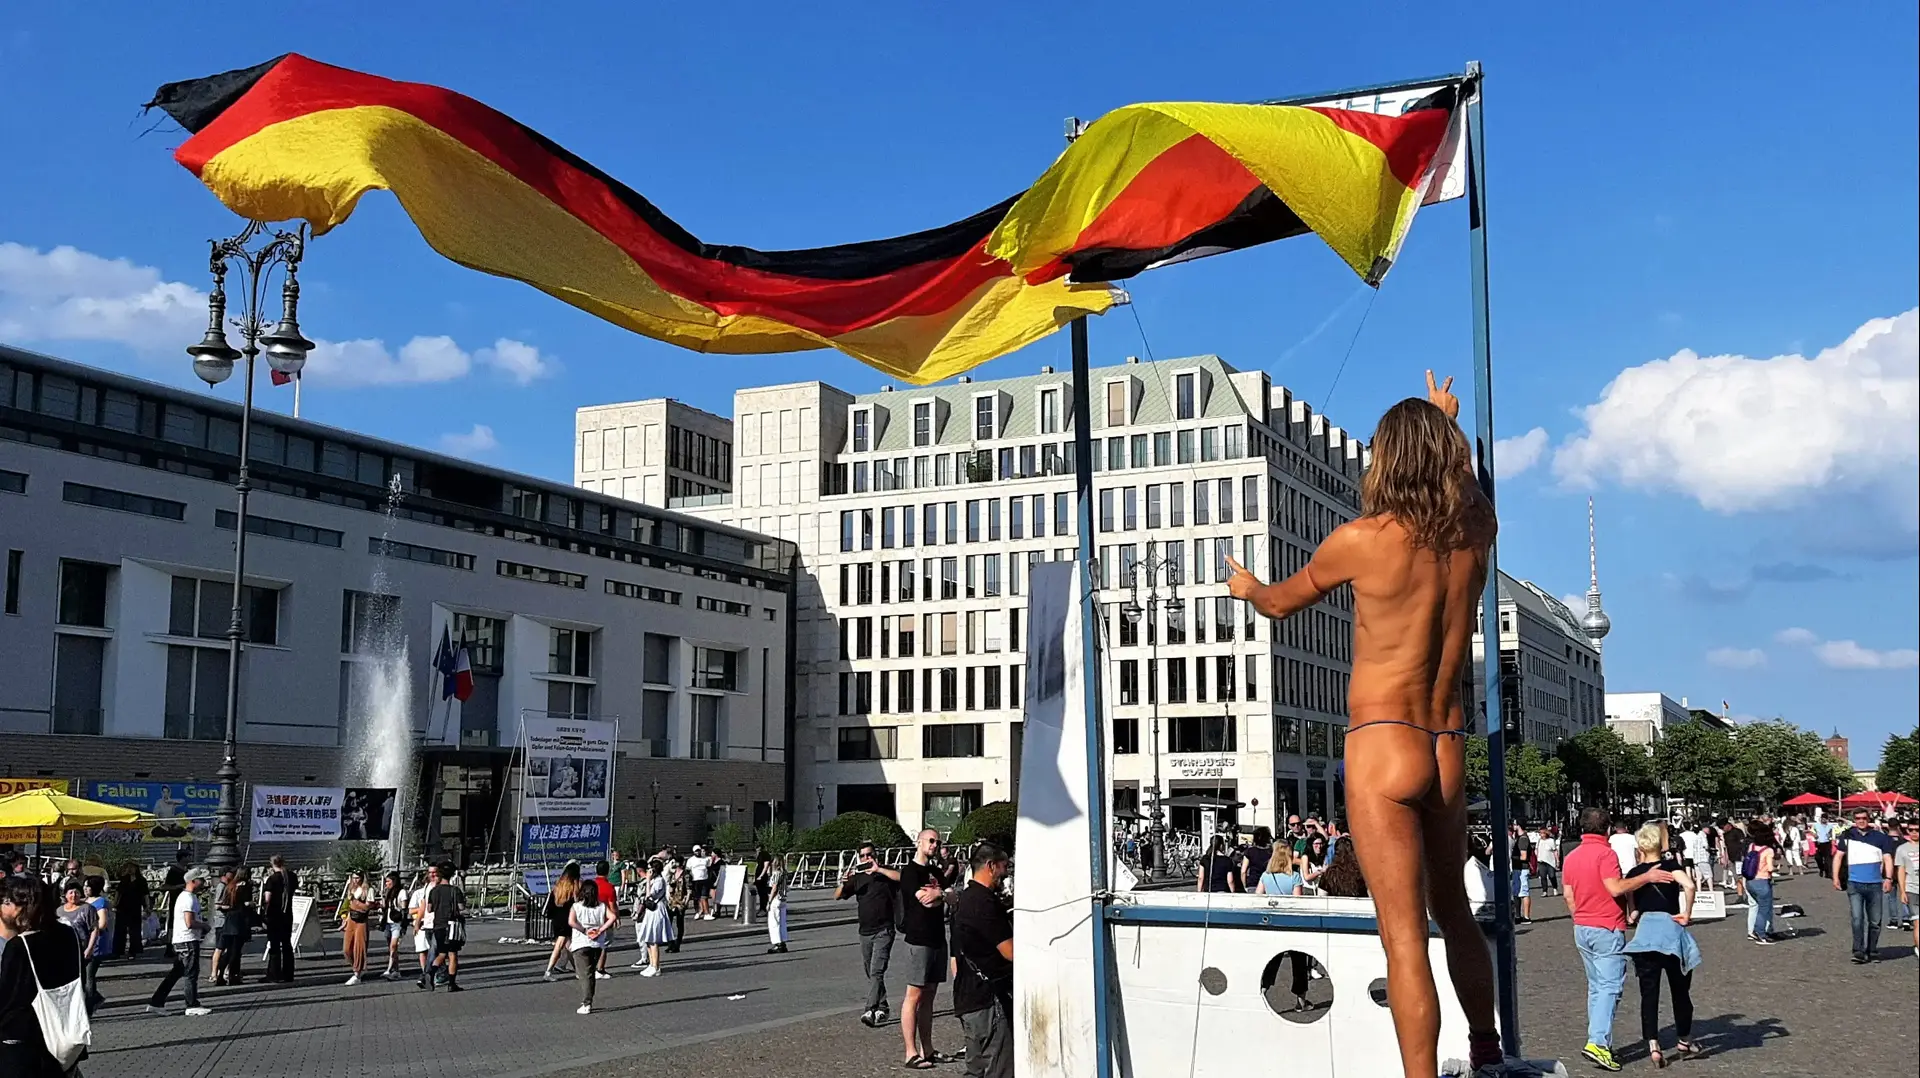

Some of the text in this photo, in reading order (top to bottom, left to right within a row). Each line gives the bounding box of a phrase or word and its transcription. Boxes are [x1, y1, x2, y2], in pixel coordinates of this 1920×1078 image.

[1170, 758, 1236, 767] STARBUCKS
[1182, 767, 1223, 777] COFFEE
[97, 783, 220, 799] Falun Gon
